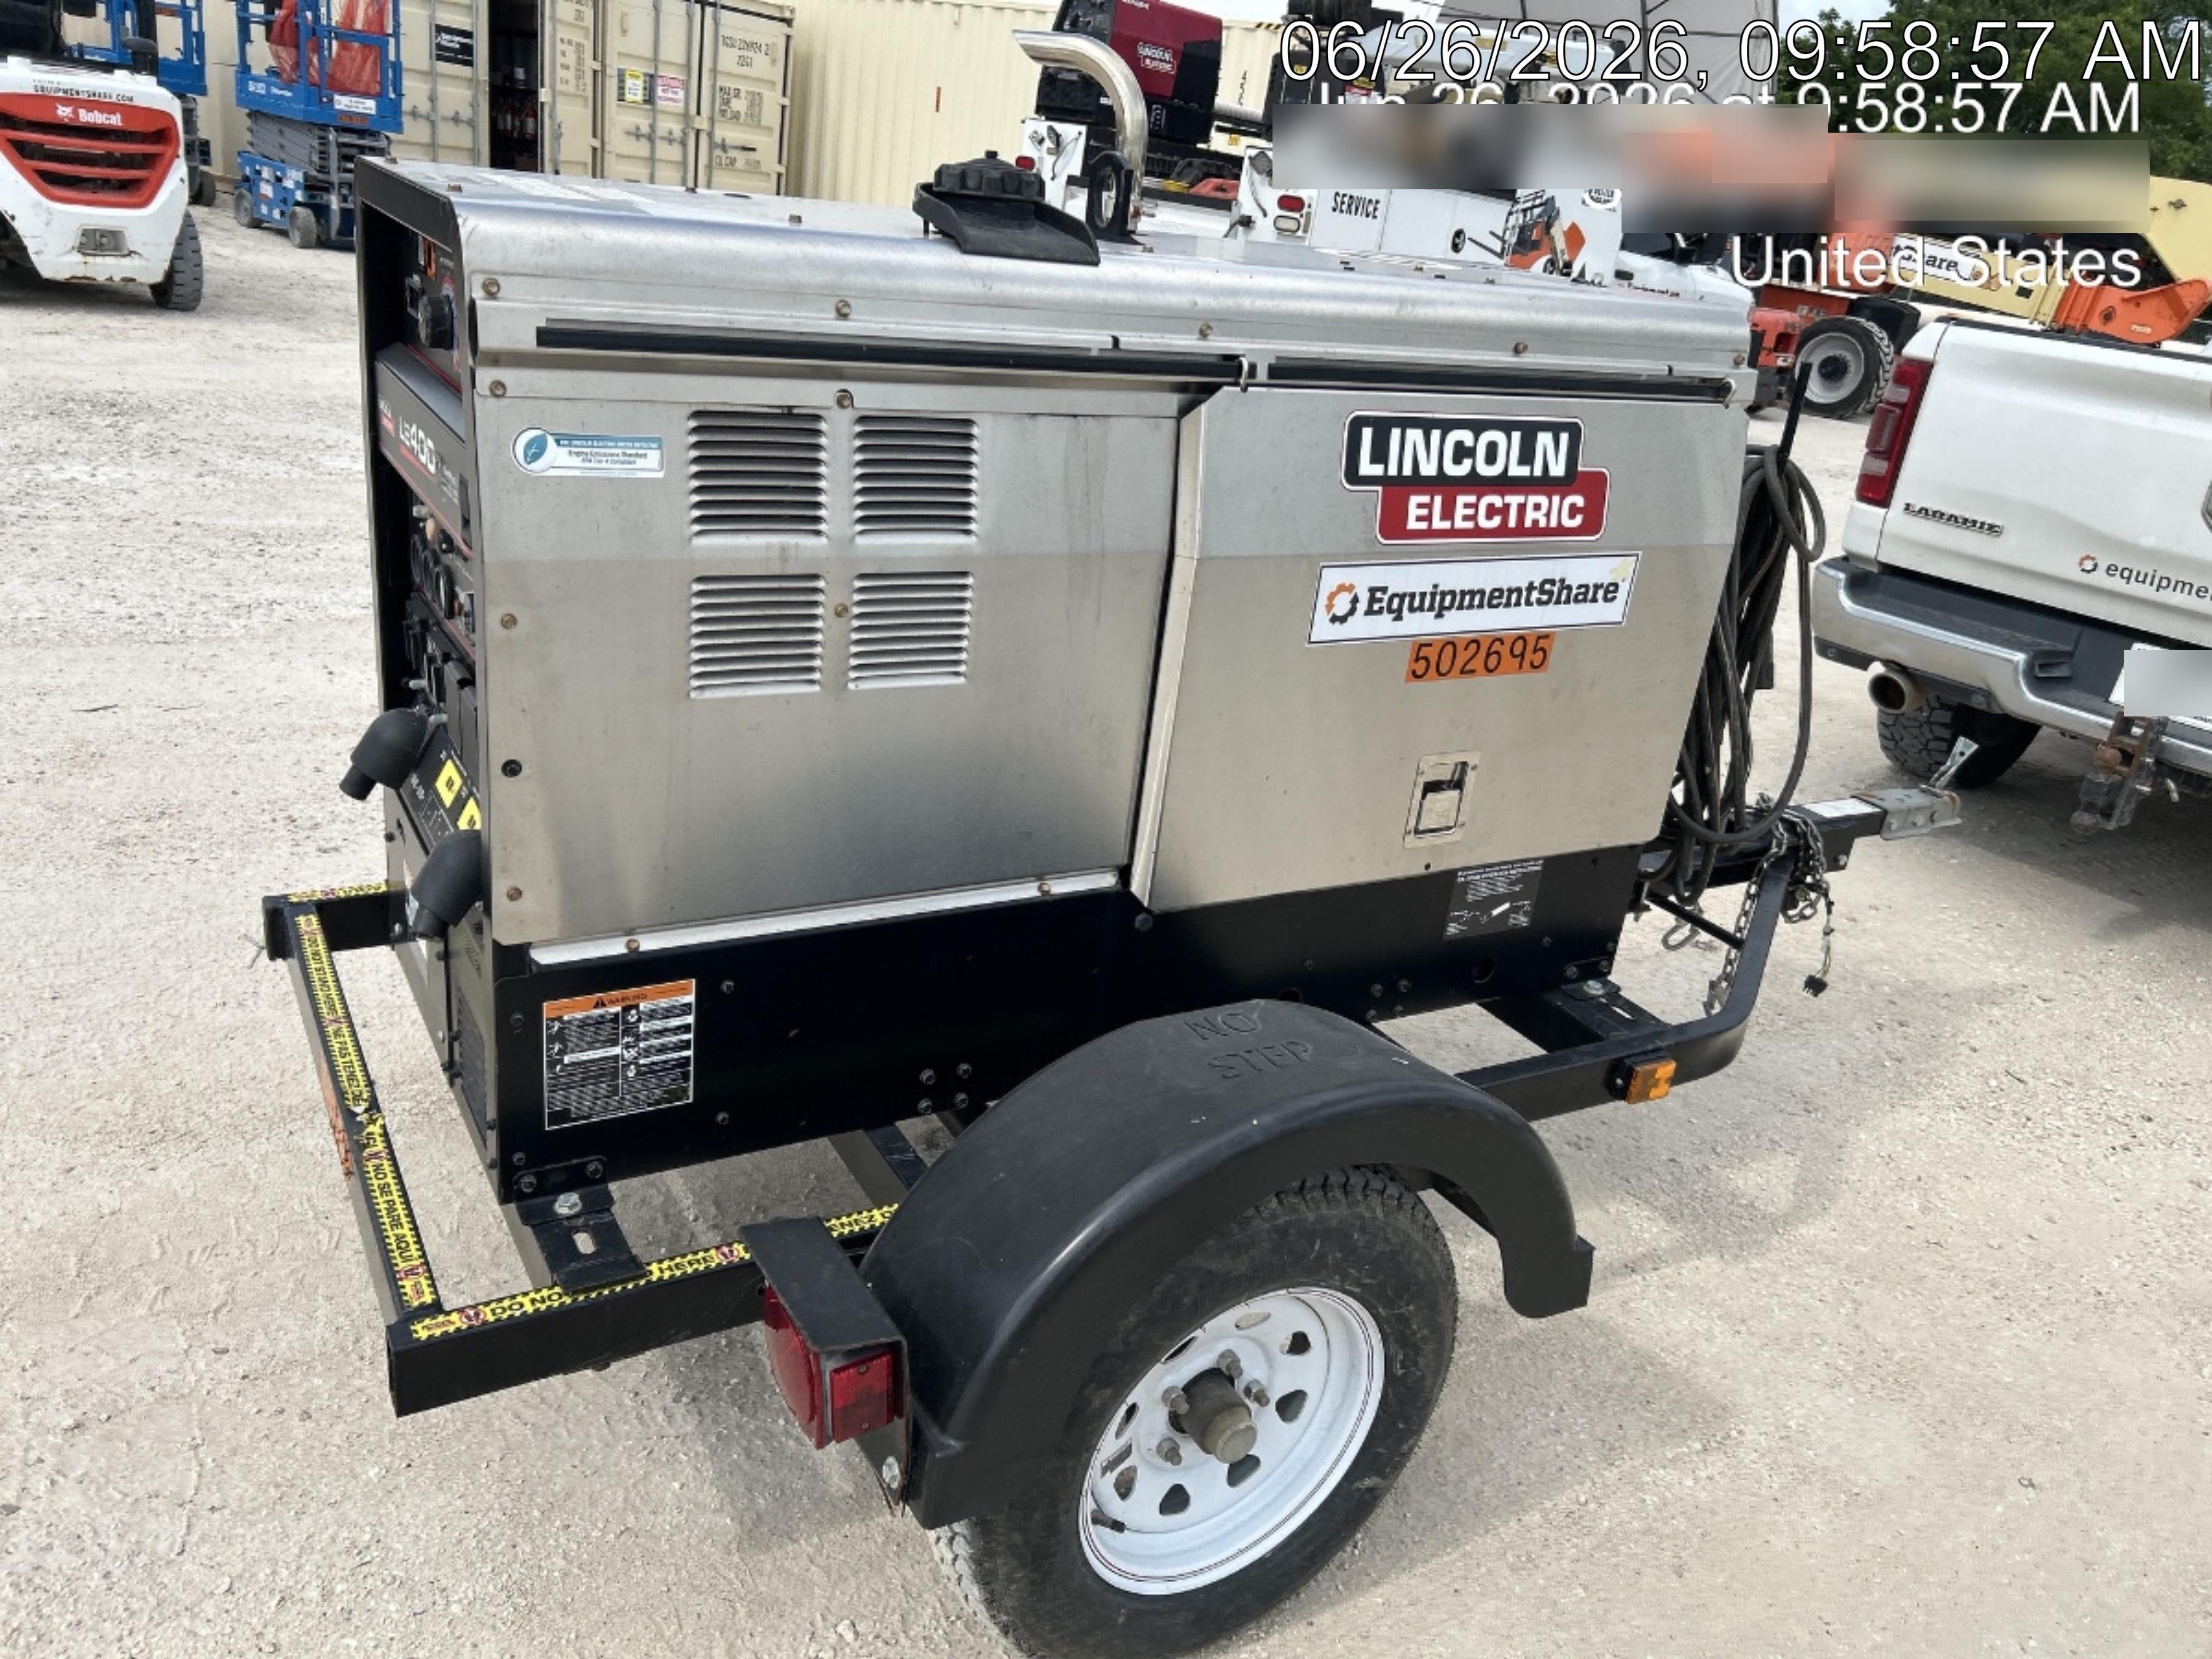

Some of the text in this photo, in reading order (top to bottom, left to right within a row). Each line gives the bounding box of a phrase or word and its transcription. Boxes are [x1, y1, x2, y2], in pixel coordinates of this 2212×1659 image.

[78, 108, 123, 125] Bobcat
[1331, 191, 1381, 220] SERVICE
[1359, 427, 1569, 476] LINCOLN
[1406, 495, 1585, 530] ELECTRIC
[1904, 502, 2005, 538] LARAMIE
[2105, 563, 2212, 600] equipme
[1364, 578, 1620, 624] EquipmentShare
[1411, 634, 1551, 680] 502695
[1183, 1011, 1261, 1040] NO
[1207, 1041, 1312, 1079] STEP
[372, 1163, 388, 1180] NO
[377, 1181, 394, 1197] SE
[383, 1198, 404, 1232] PARE
[393, 1232, 420, 1263] AQUÍ
[490, 1301, 524, 1316] DO
